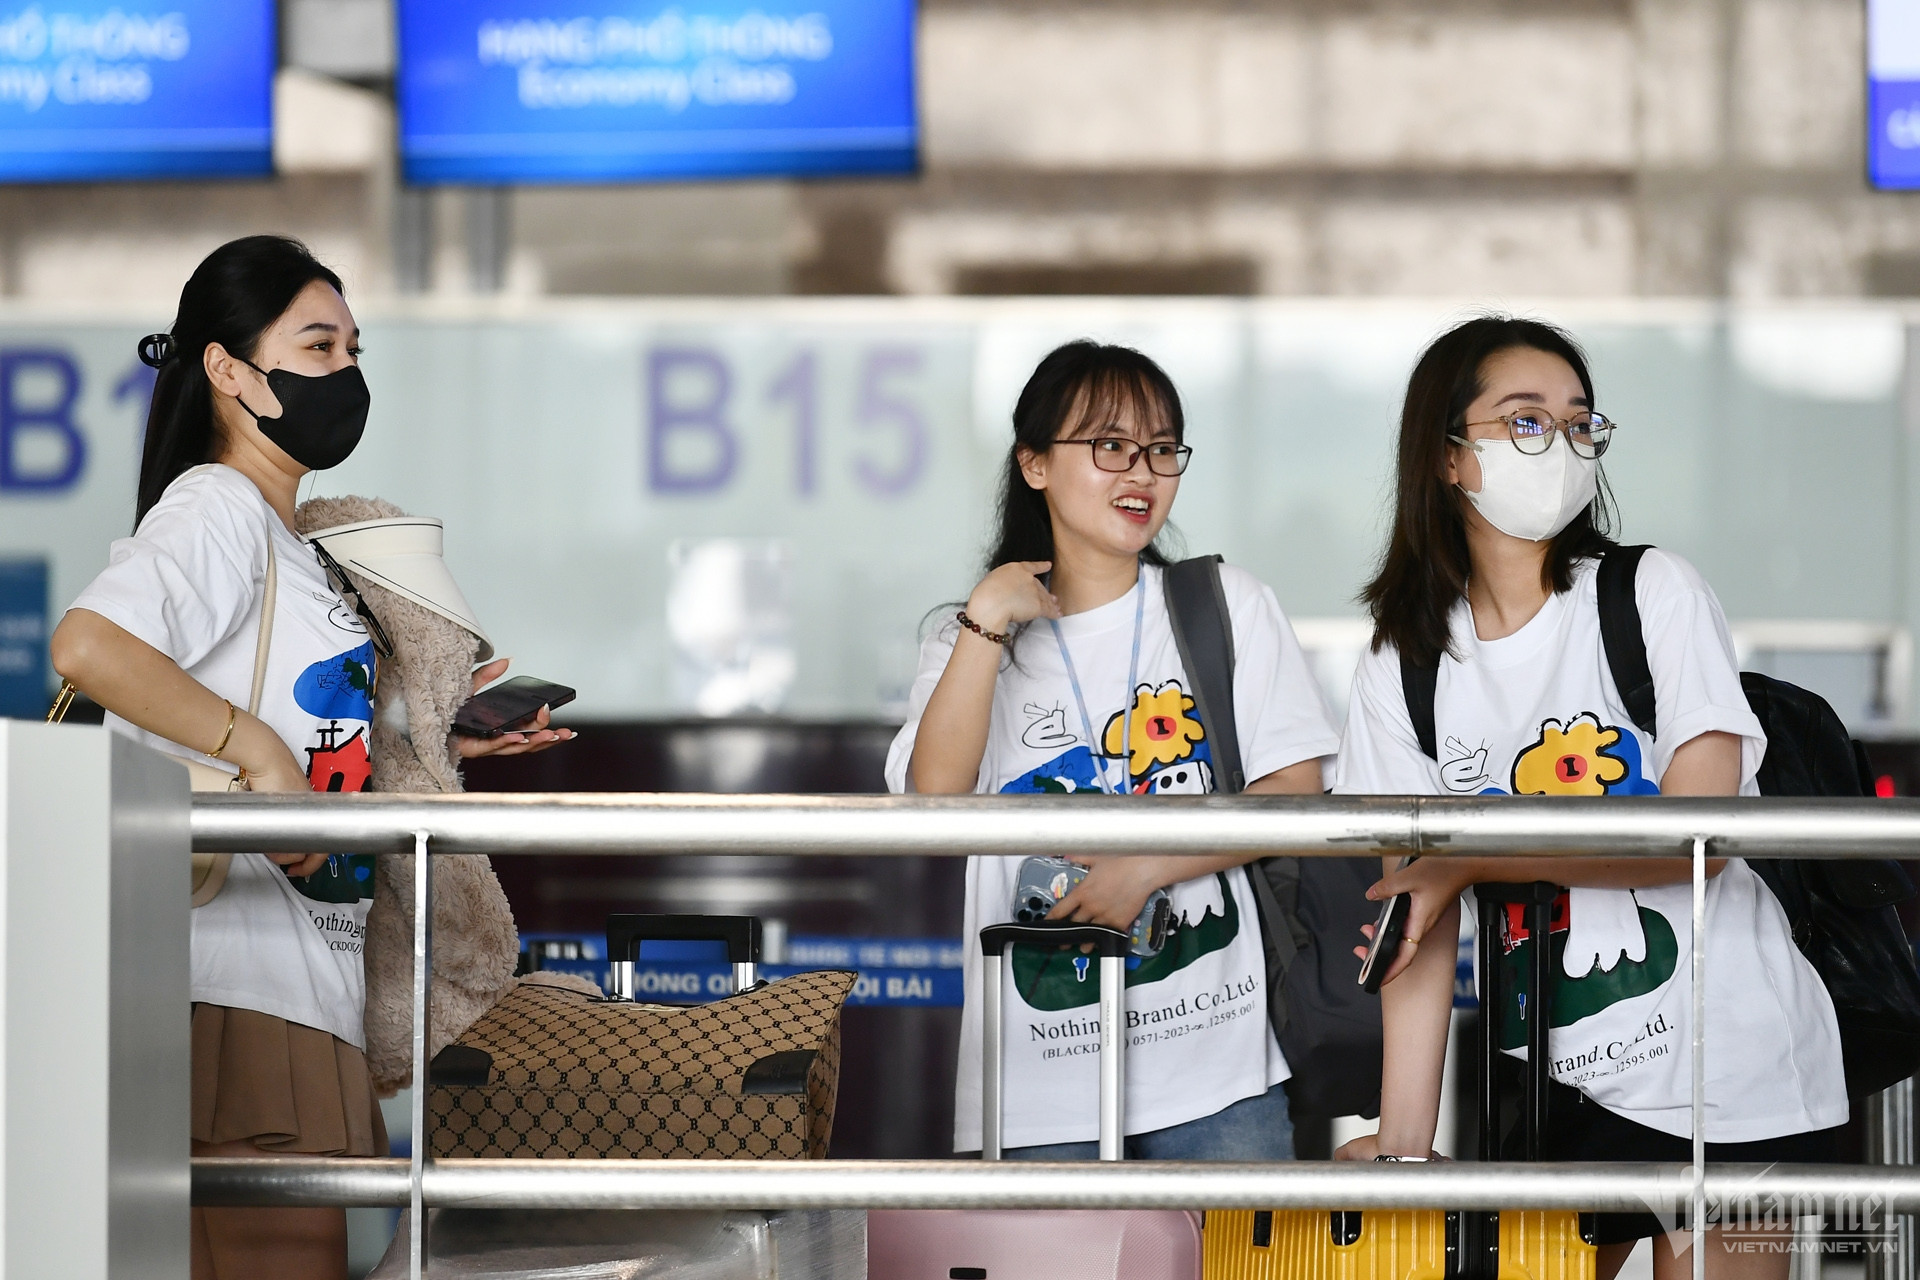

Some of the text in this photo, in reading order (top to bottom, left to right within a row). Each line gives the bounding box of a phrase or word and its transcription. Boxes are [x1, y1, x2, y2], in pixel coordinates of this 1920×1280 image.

[644, 346, 933, 496] B15
[308, 911, 361, 938] othing
[1029, 1017, 1101, 1041] Nothin
